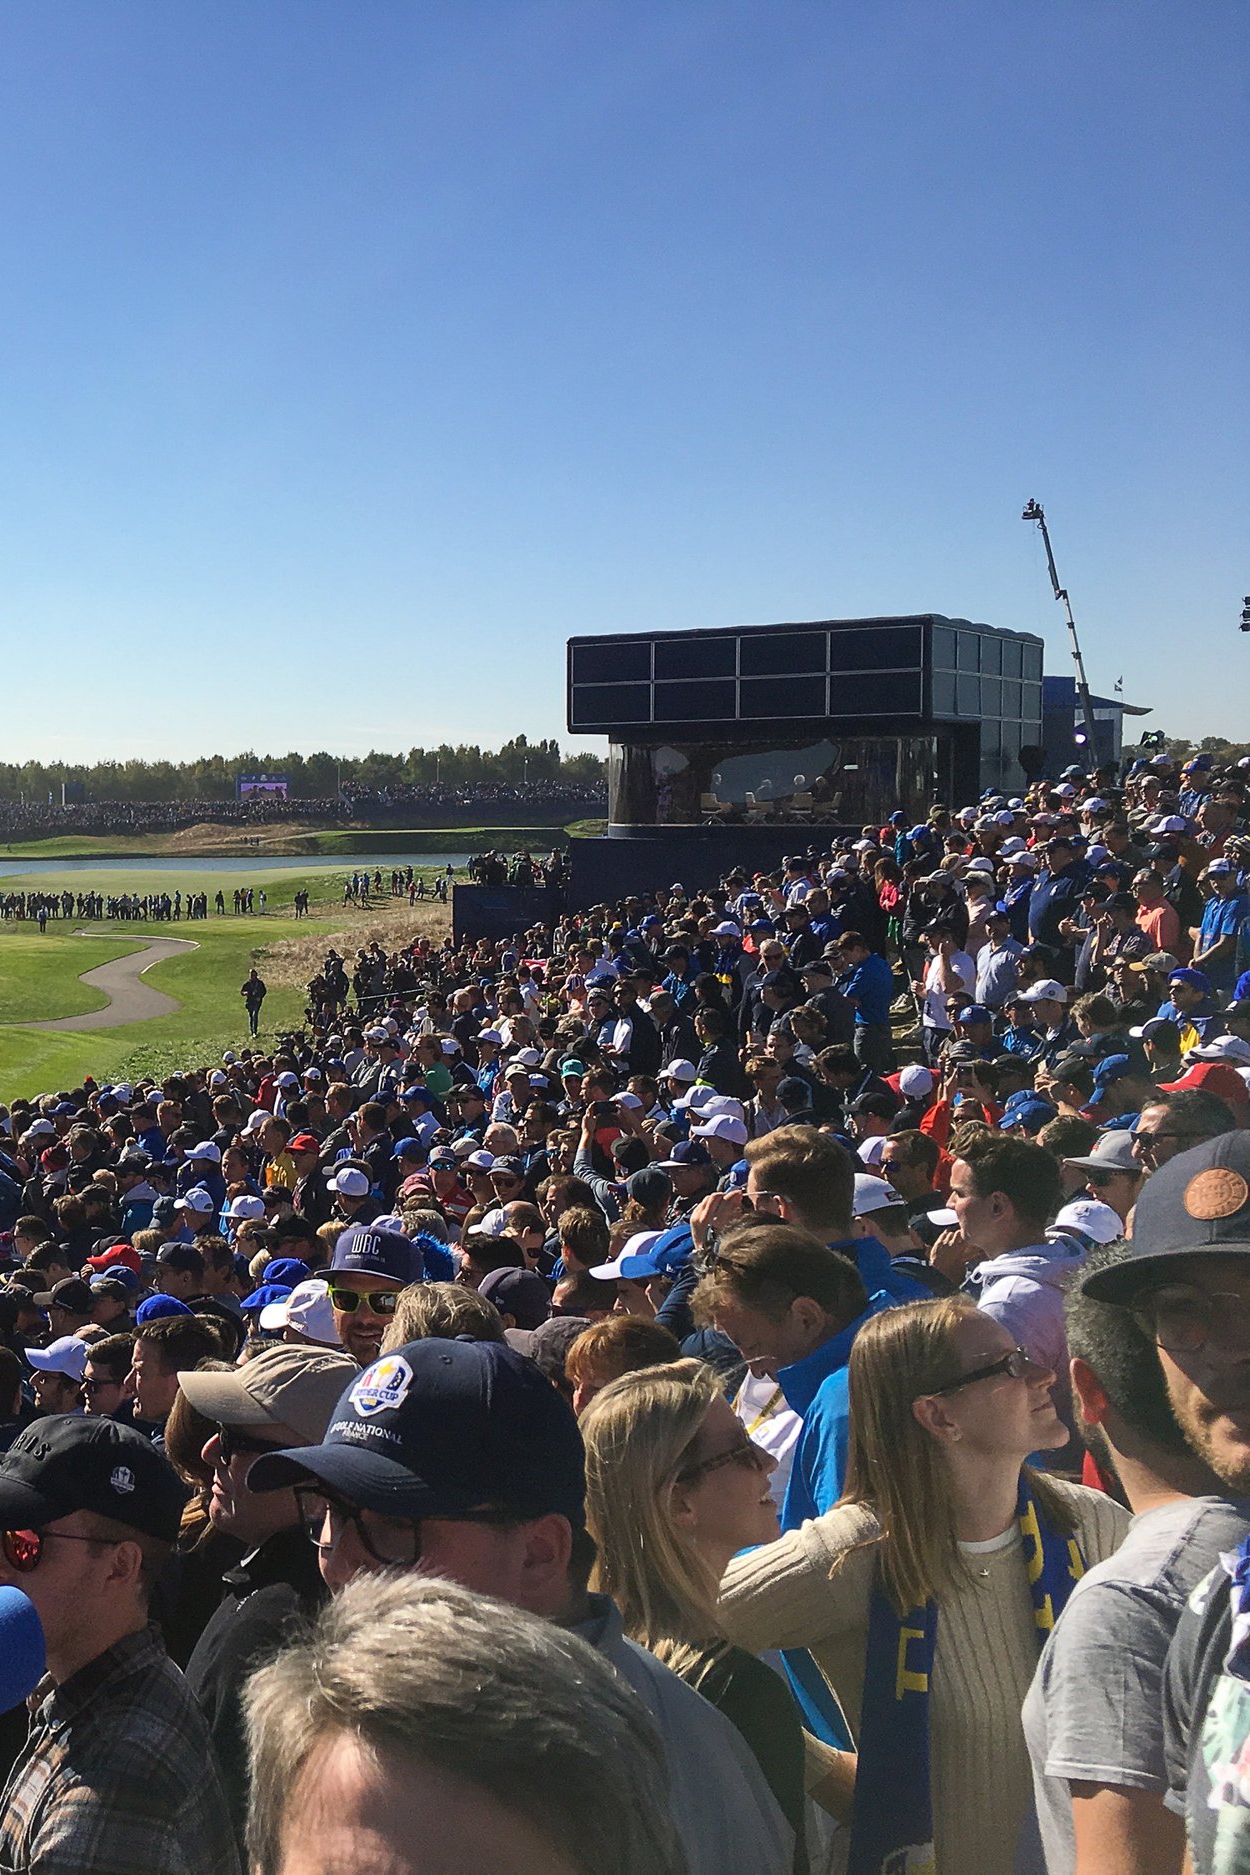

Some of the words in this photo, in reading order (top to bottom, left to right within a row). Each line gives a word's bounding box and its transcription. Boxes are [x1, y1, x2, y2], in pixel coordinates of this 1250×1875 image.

[351, 1233, 381, 1255] WBC
[379, 1390, 399, 1401] CUP
[354, 1421, 403, 1444] NATIONAL
[11, 1433, 50, 1459] RIS
